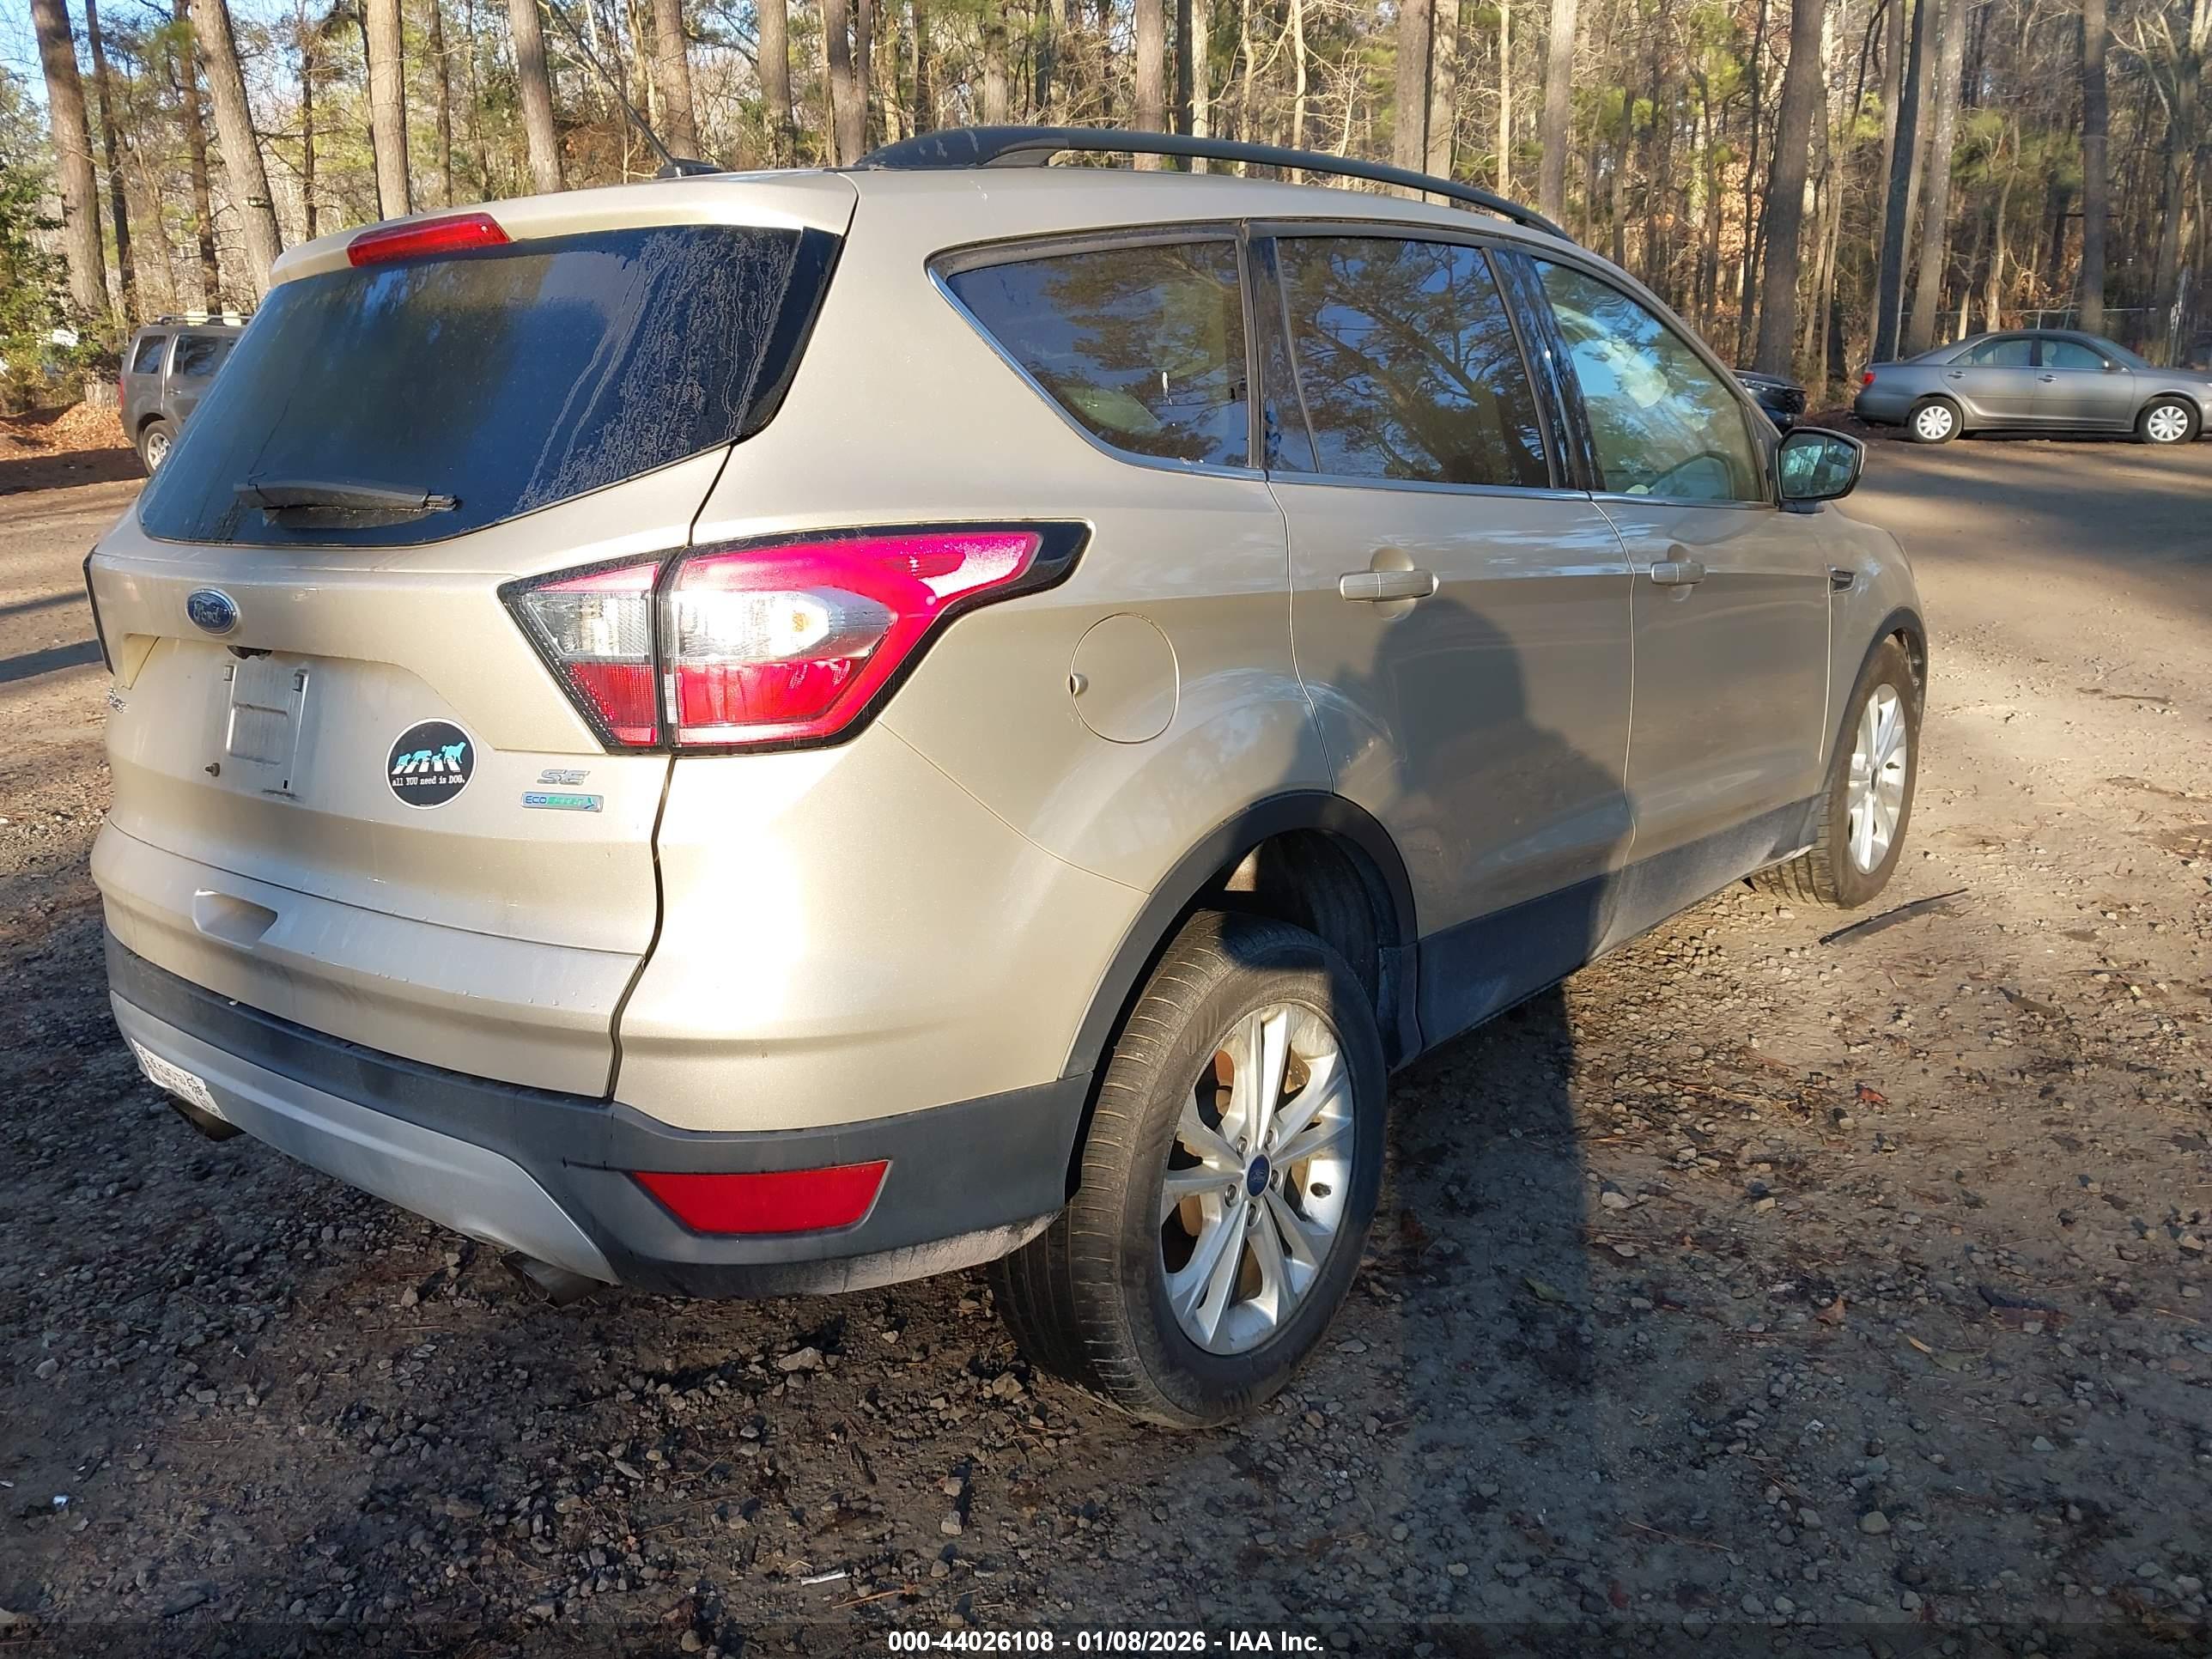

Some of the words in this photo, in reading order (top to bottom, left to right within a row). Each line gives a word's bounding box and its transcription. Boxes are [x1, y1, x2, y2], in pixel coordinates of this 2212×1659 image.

[392, 777, 404, 787] all
[405, 776, 418, 786] YOU
[420, 775, 436, 785] need
[438, 775, 447, 784] is
[537, 769, 591, 786] SE
[525, 795, 585, 806] ECOT
